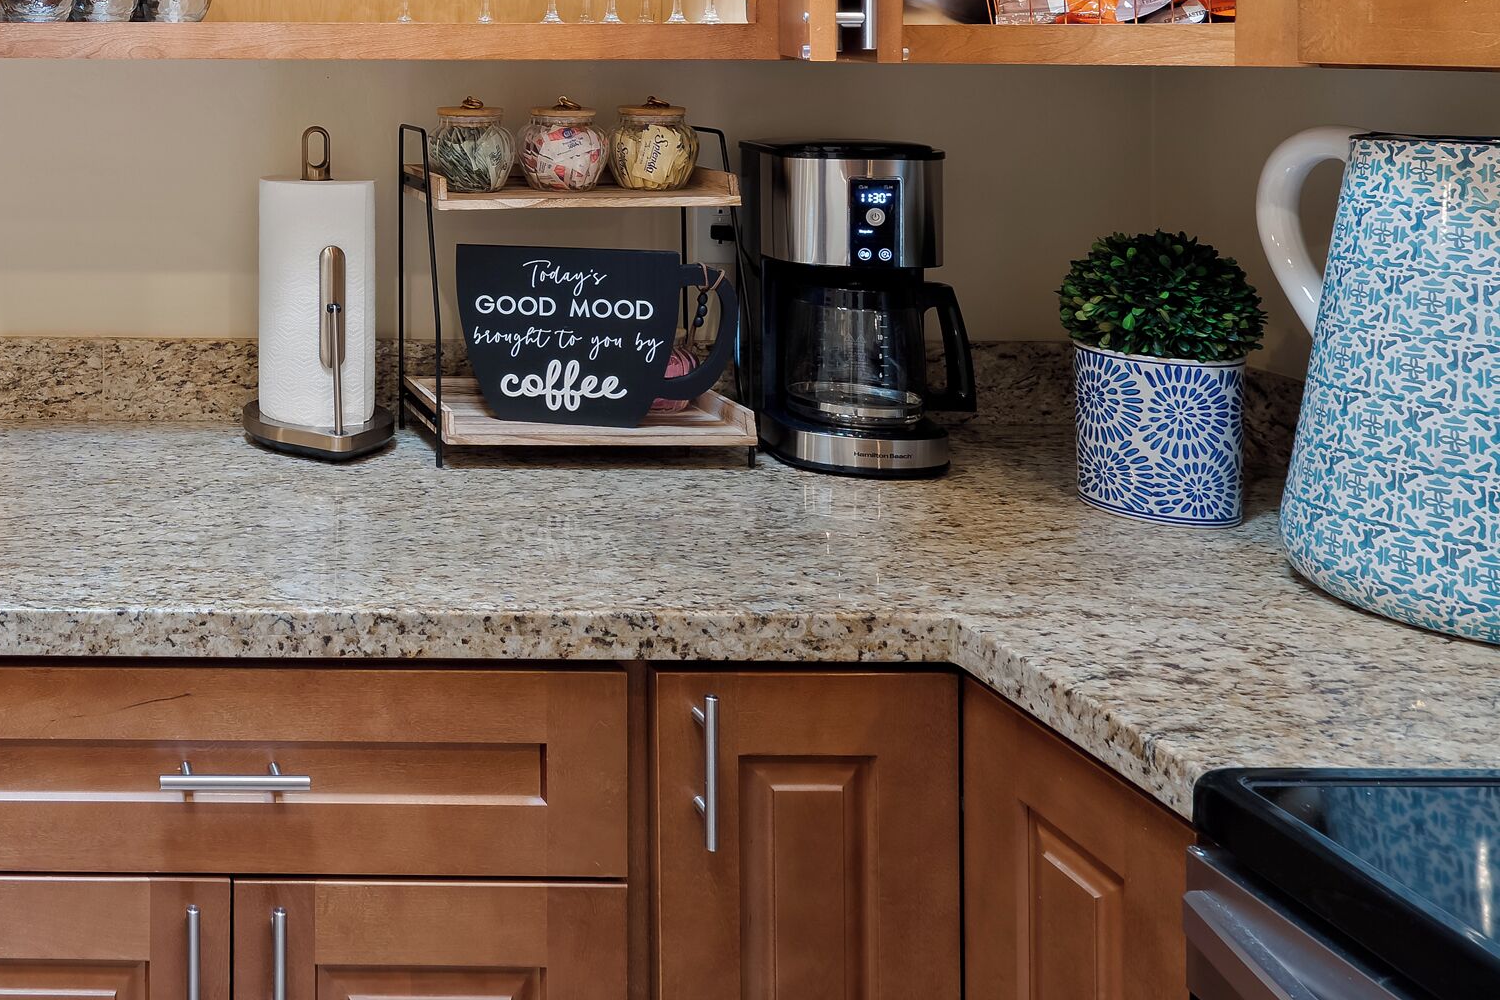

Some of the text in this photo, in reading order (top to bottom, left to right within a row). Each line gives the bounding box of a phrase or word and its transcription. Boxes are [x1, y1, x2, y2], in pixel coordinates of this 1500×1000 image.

[644, 133, 669, 175] Splenda
[861, 192, 887, 204] 11:30
[522, 259, 607, 296] Today's
[475, 294, 654, 320] GOOD MOOD
[473, 326, 665, 363] brought to you by
[499, 359, 628, 412] coffee
[853, 450, 889, 459] Hamilton
